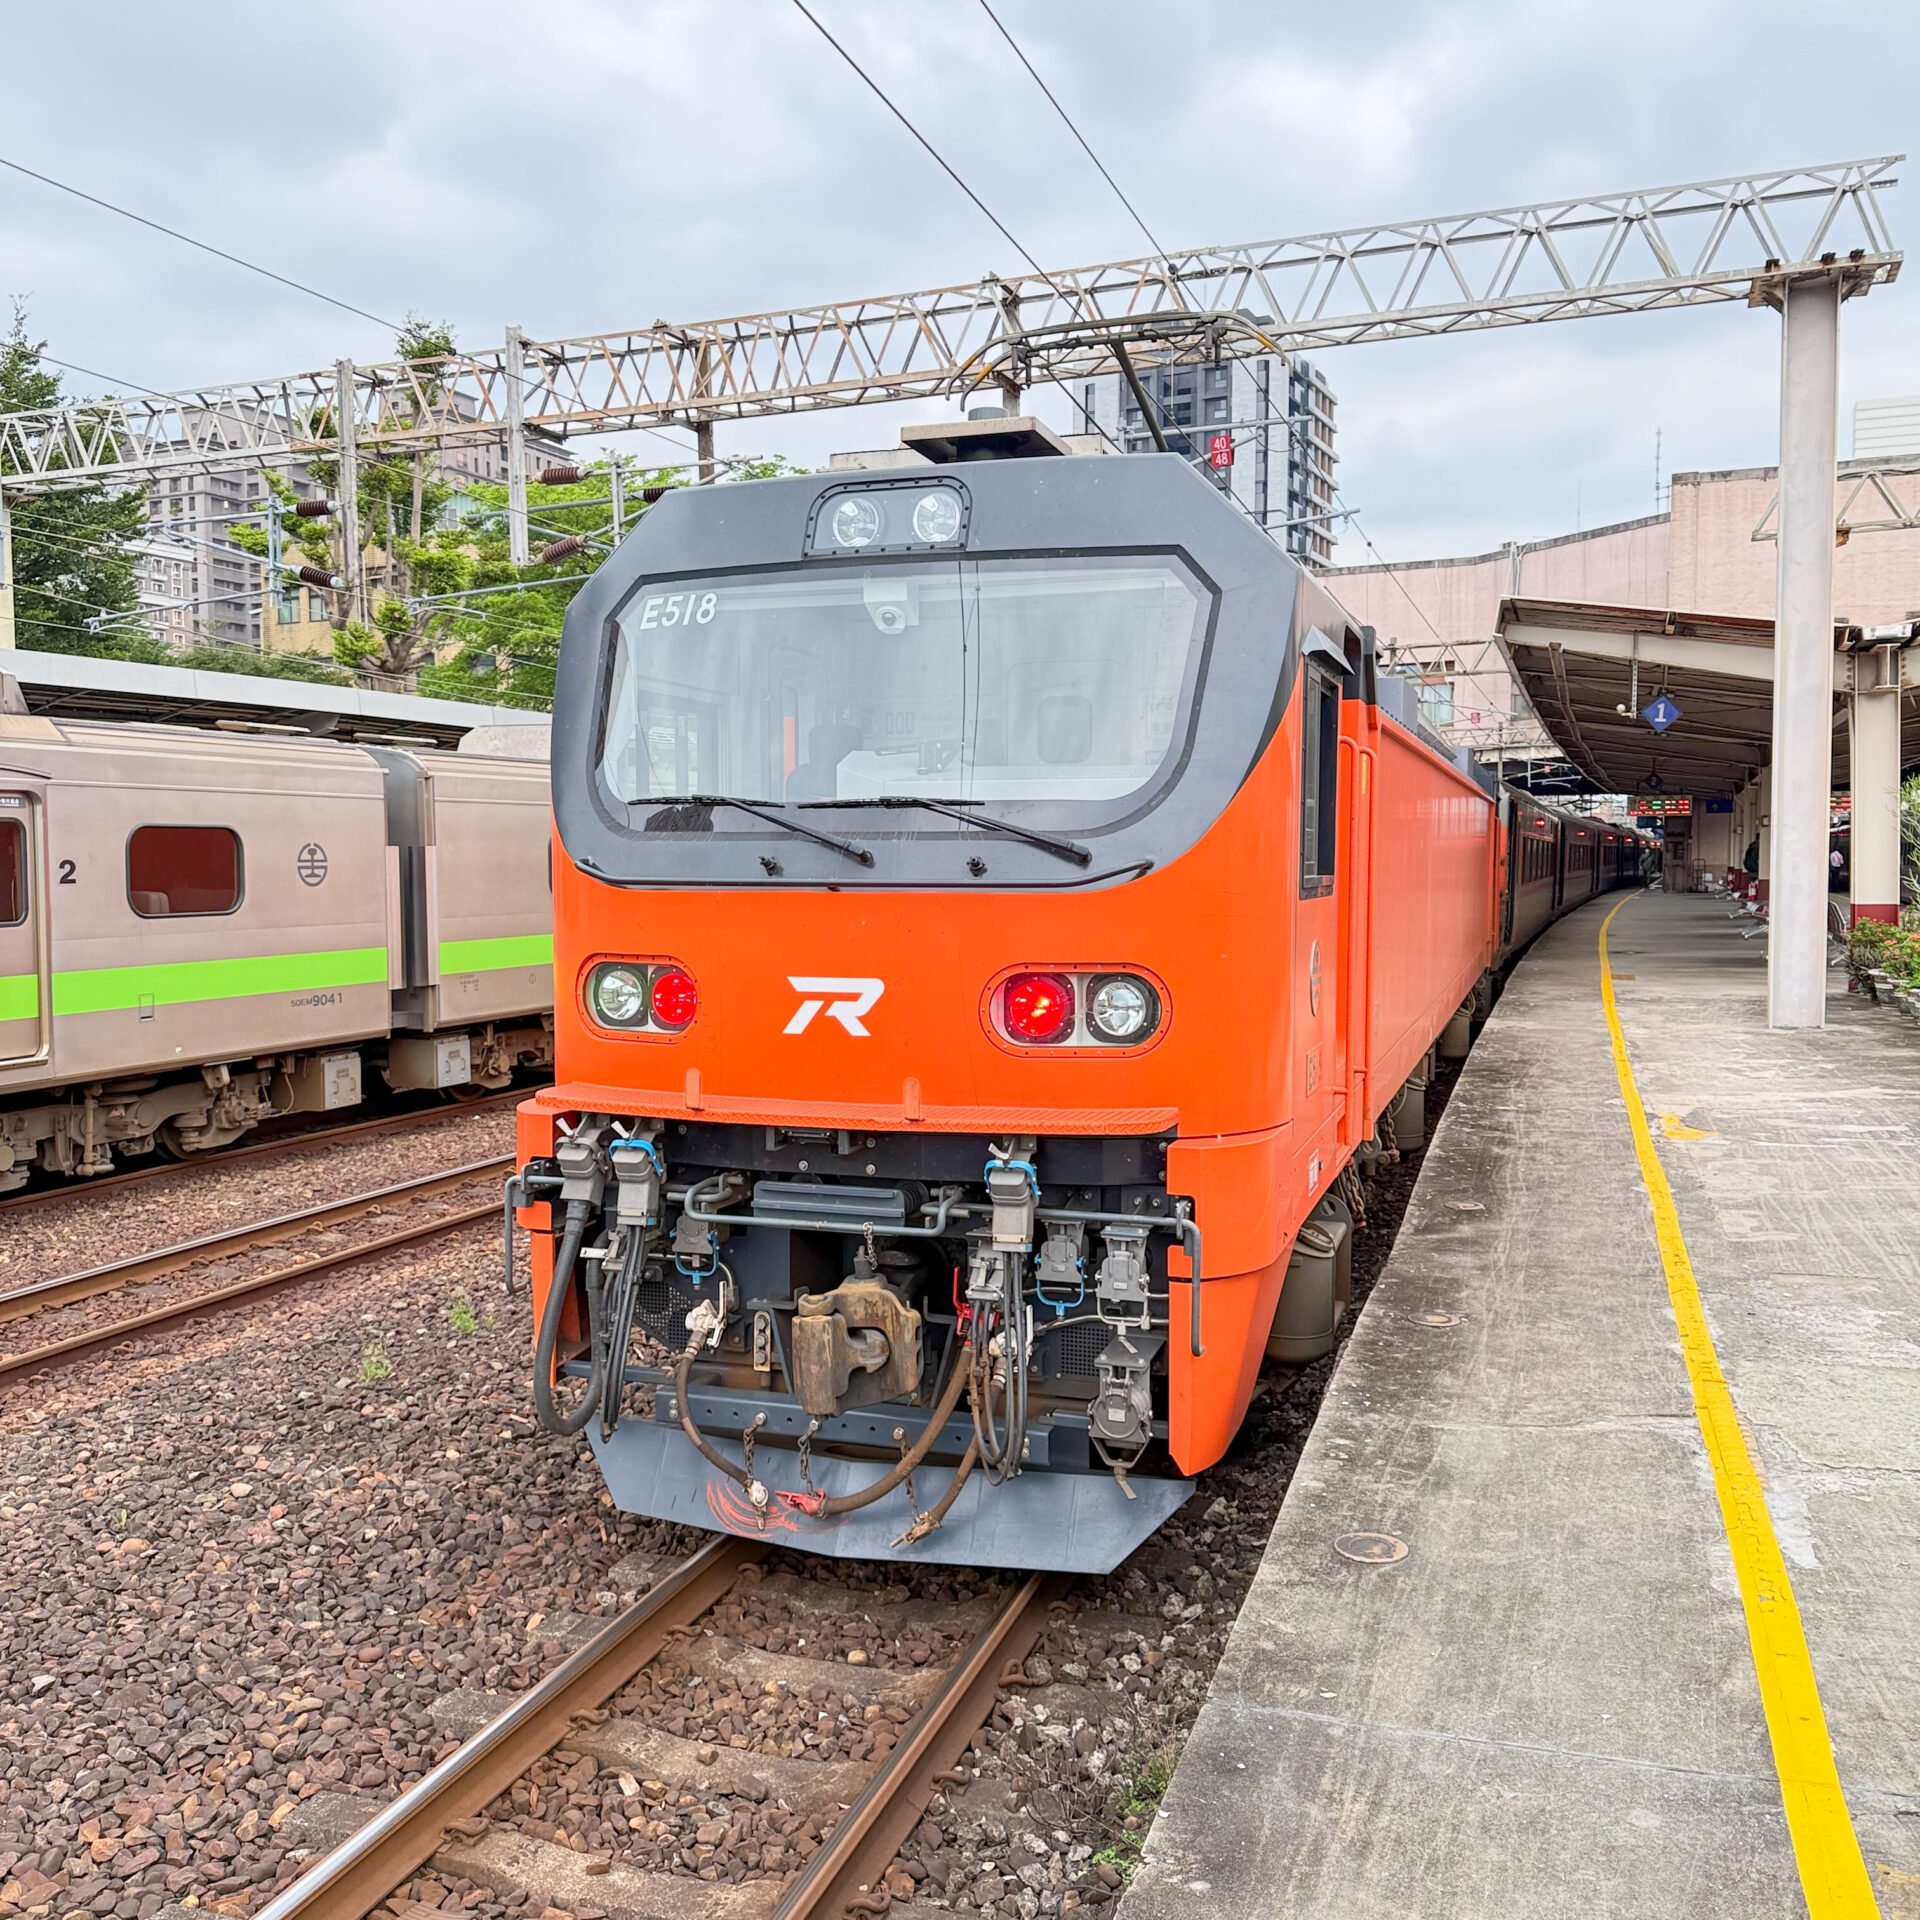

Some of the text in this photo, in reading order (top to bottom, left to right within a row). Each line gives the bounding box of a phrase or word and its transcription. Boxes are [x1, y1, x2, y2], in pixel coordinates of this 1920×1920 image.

[1213, 437, 1227, 450] 40
[1215, 452, 1229, 465] 48
[640, 592, 718, 630] E518
[1654, 702, 1667, 723] 1
[58, 859, 77, 884] 2
